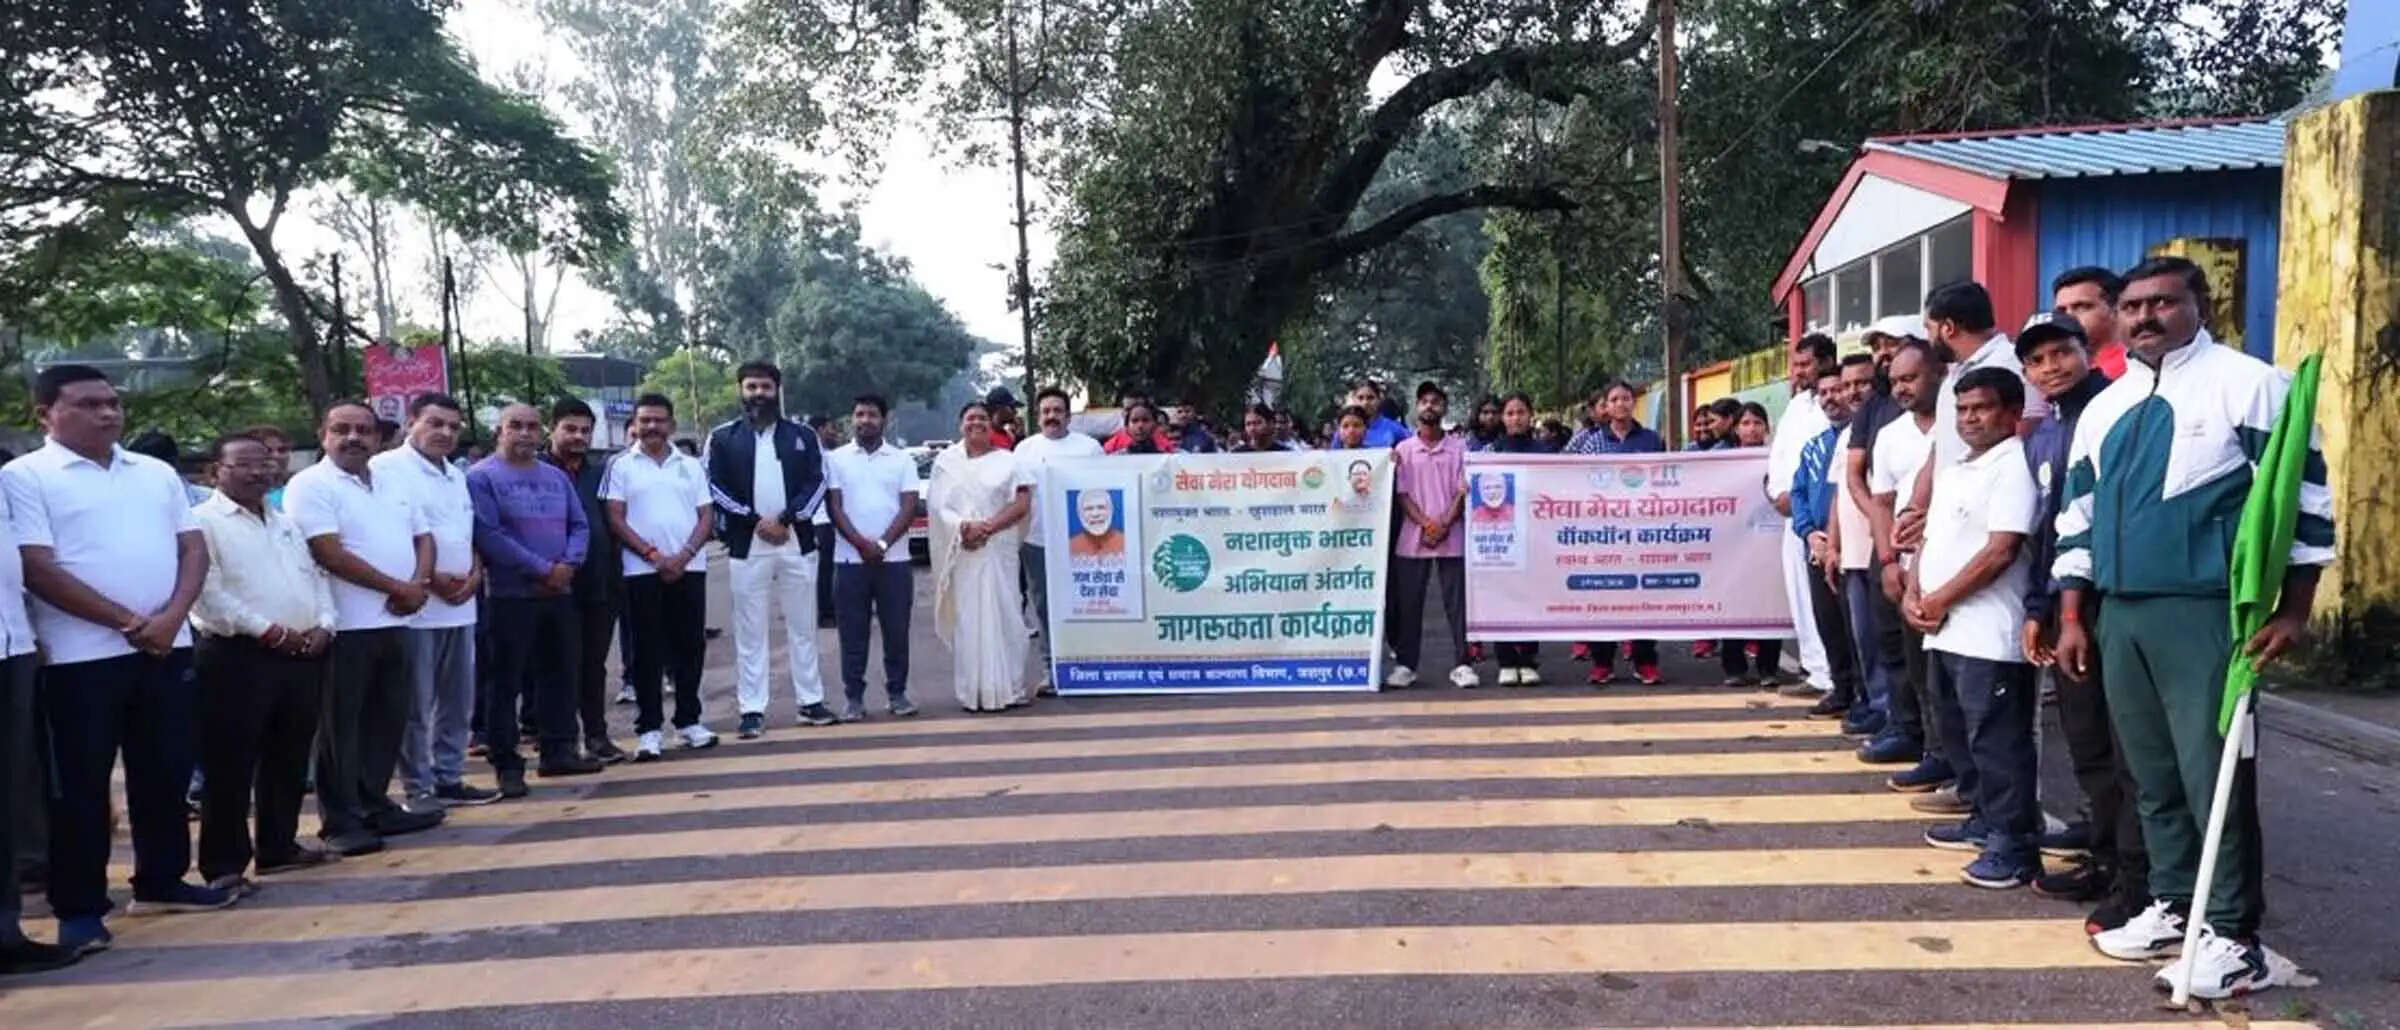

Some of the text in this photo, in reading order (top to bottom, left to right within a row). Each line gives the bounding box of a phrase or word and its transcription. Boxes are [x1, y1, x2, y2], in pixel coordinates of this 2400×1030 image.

[1175, 467, 1297, 491] सेवा मेरा योगदान
[1531, 493, 1738, 520] सेवा मेरा योगदान
[1223, 528, 1376, 557] नशामुक्त भारत
[1637, 522, 1712, 545] कार्यक्रम
[1224, 564, 1376, 593] अभियान अंतर्गत
[1154, 601, 1377, 641] जागरूकता कार्यक्रम
[1069, 666, 1100, 681] जिला
